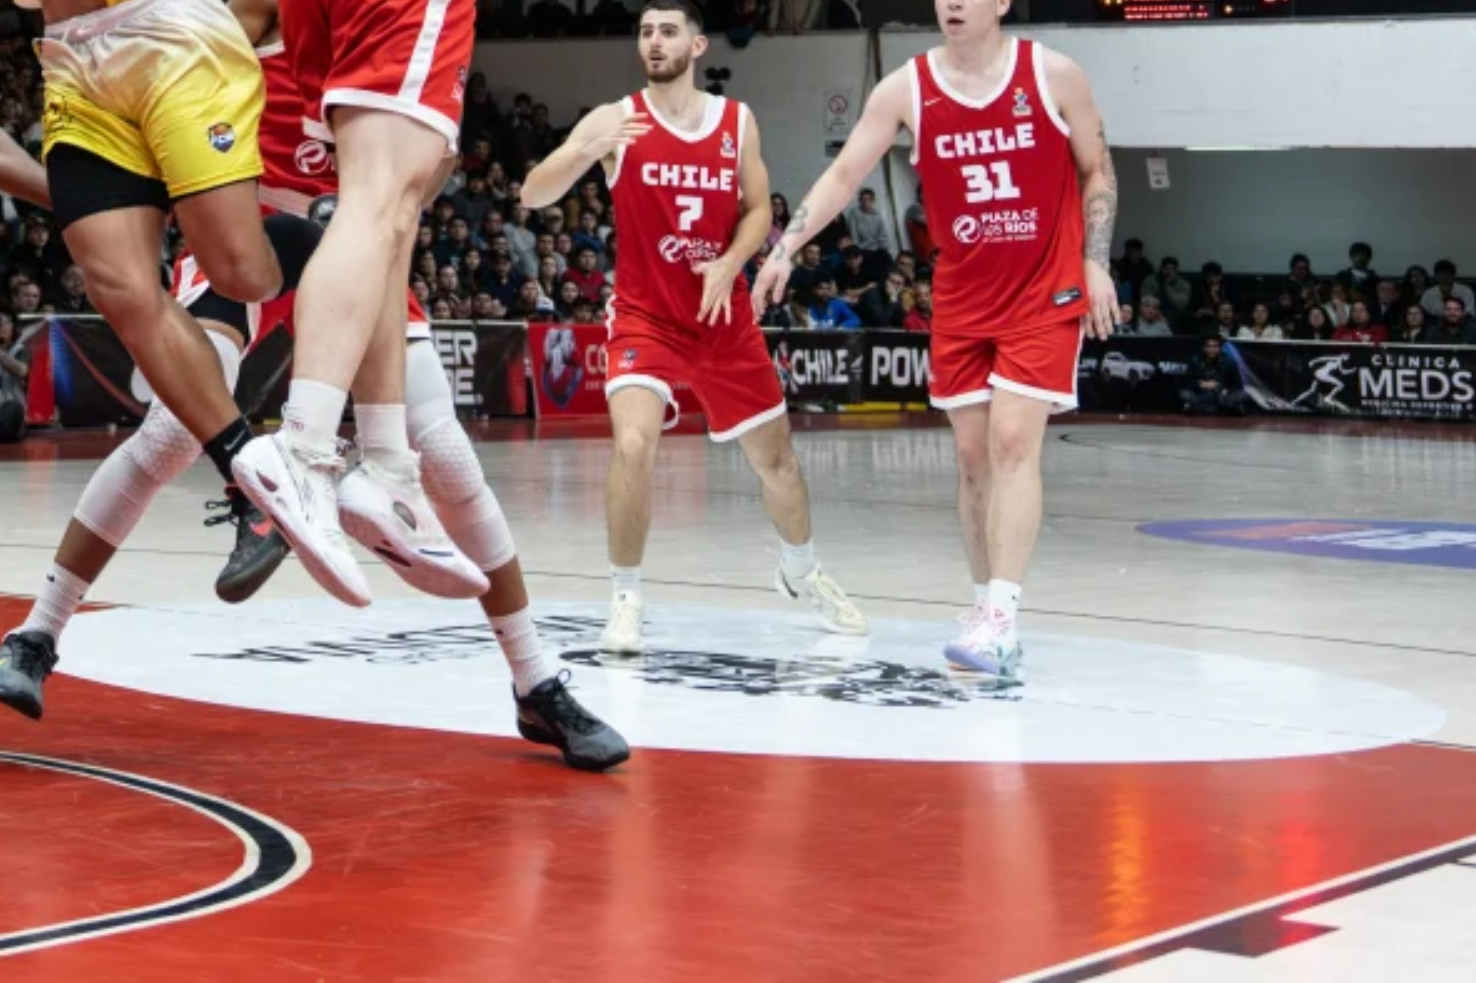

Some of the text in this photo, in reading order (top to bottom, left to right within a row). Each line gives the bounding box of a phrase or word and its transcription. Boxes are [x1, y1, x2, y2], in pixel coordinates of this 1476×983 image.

[935, 122, 1035, 159] CHILE
[642, 162, 734, 192] CHILE
[961, 160, 1021, 203] 31
[675, 194, 703, 231] 7
[791, 348, 849, 387] CHILE
[1358, 368, 1474, 402] MEDS
